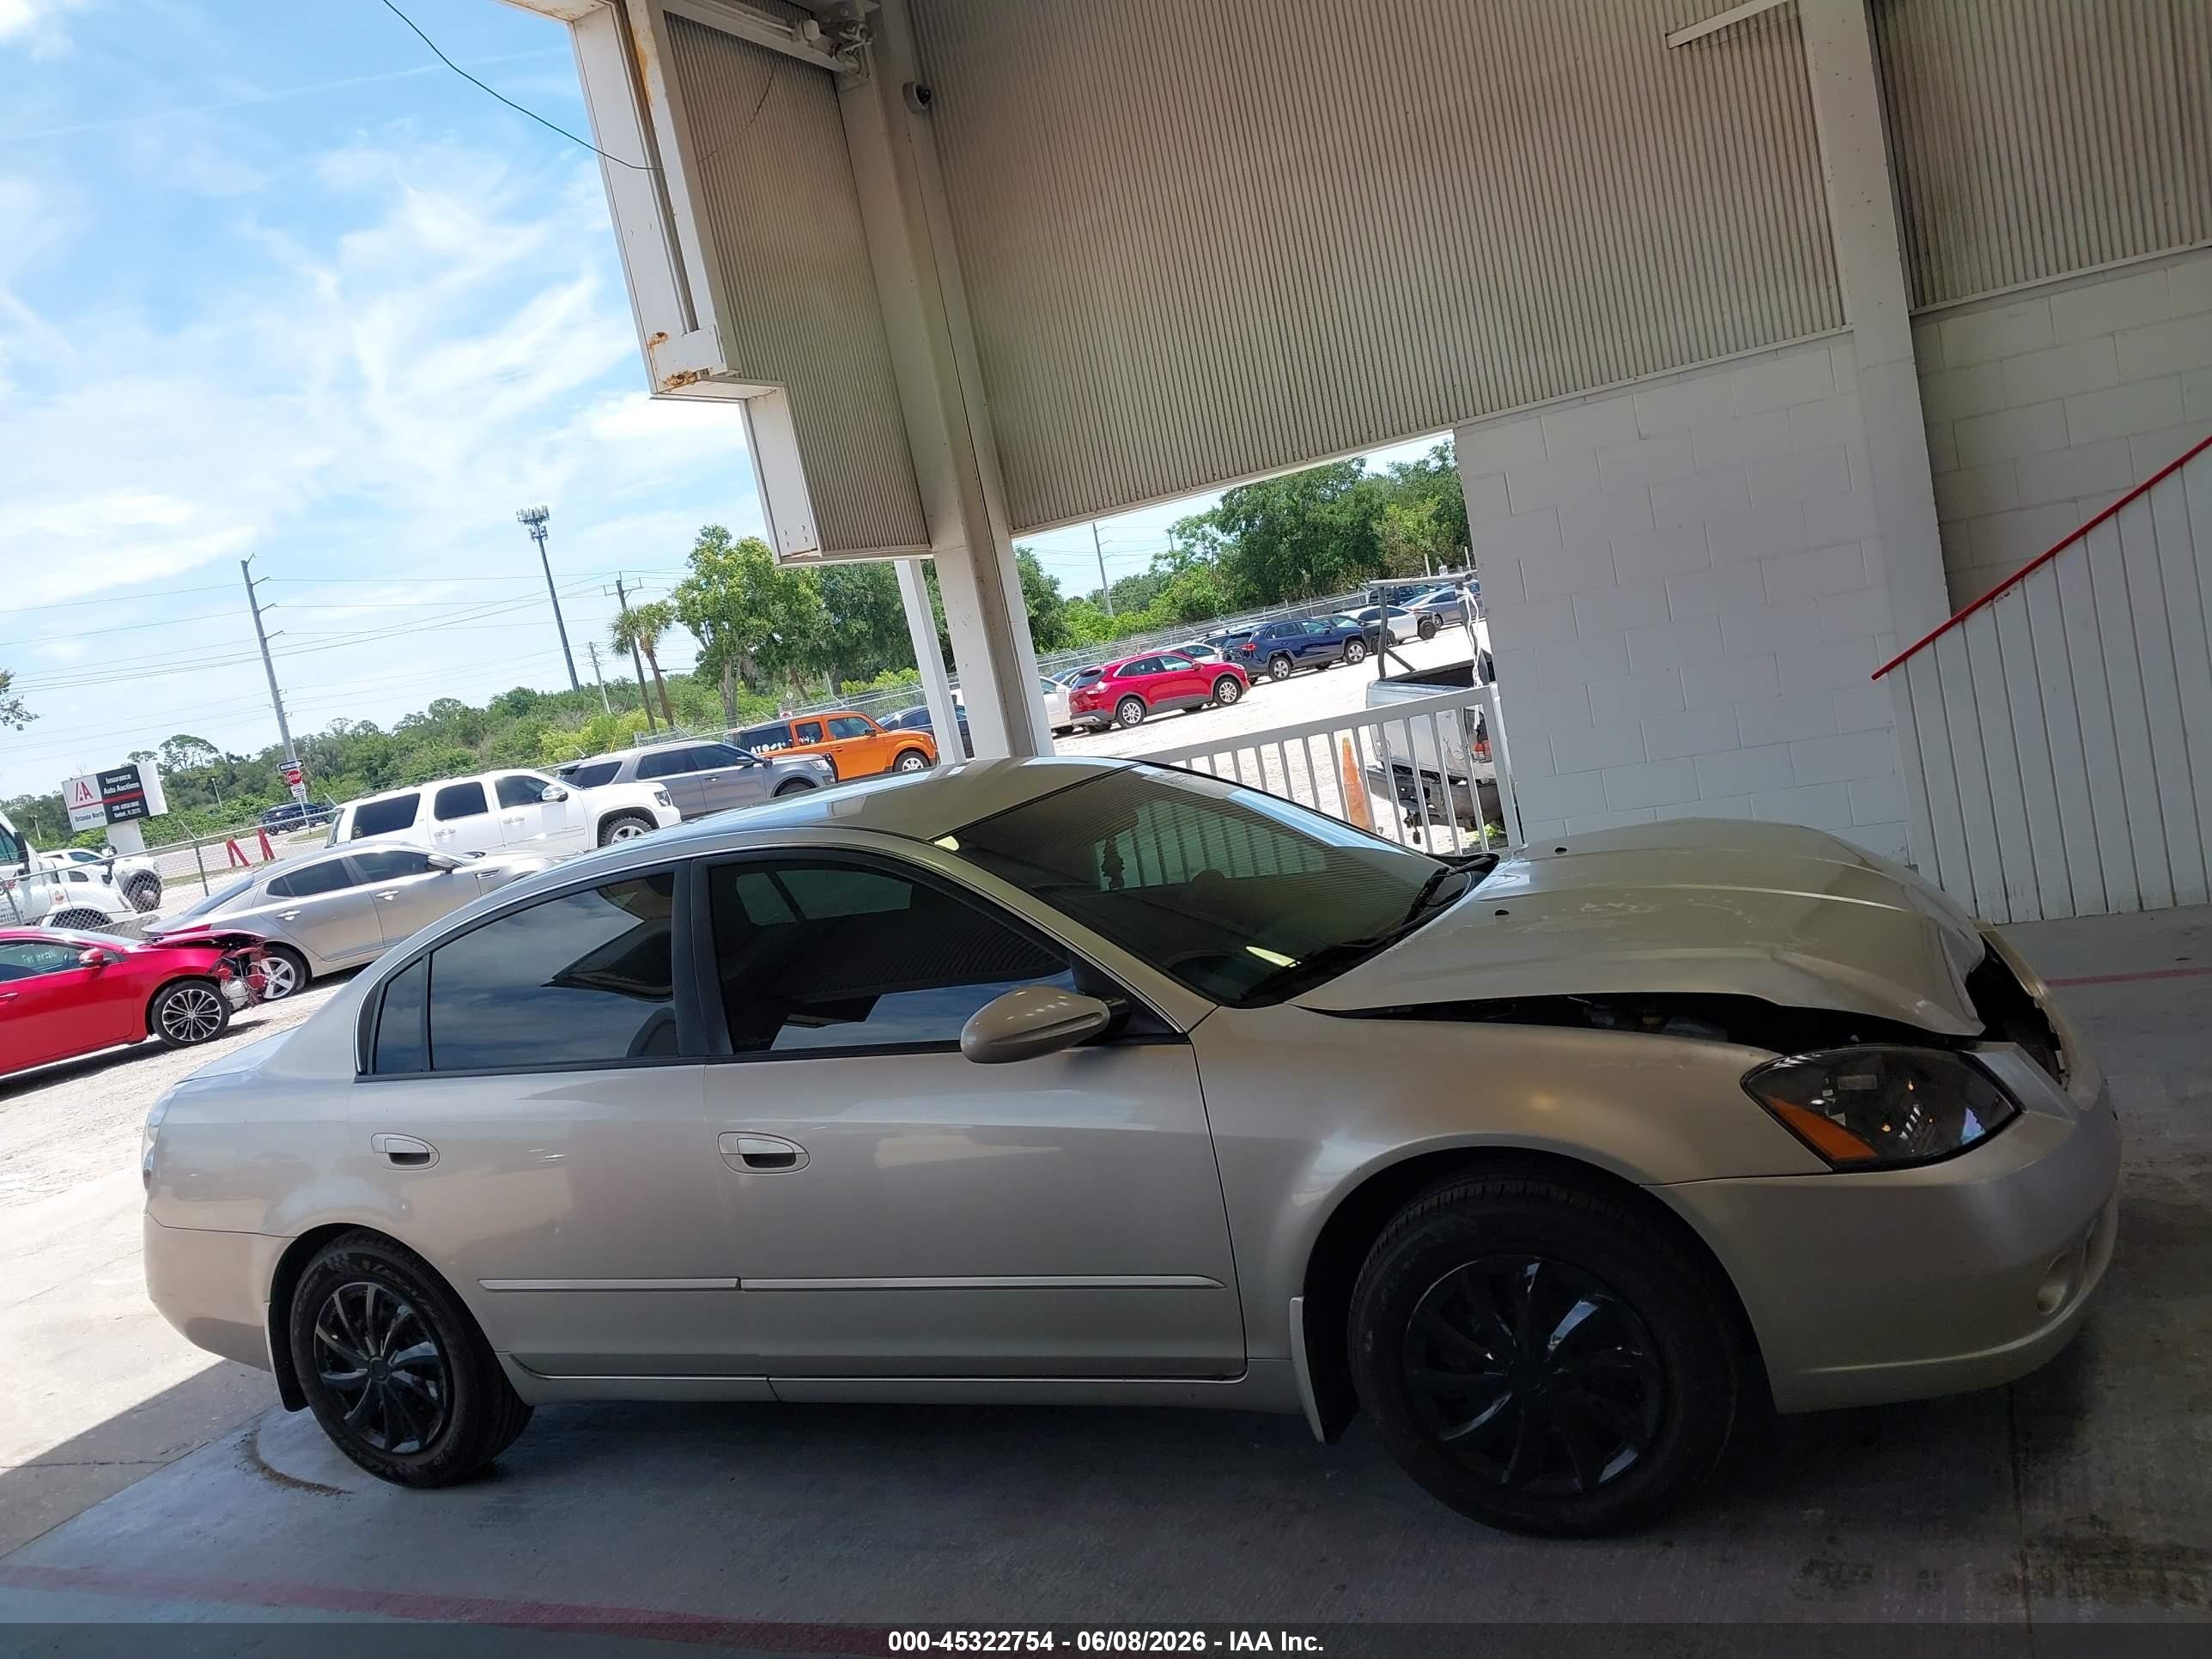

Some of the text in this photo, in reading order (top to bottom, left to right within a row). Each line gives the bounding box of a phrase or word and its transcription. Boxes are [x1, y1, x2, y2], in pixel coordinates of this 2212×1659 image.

[105, 774, 131, 785] Insurance
[117, 781, 140, 792] Auctions
[75, 814, 92, 823] Orlando
[92, 811, 105, 819] North
